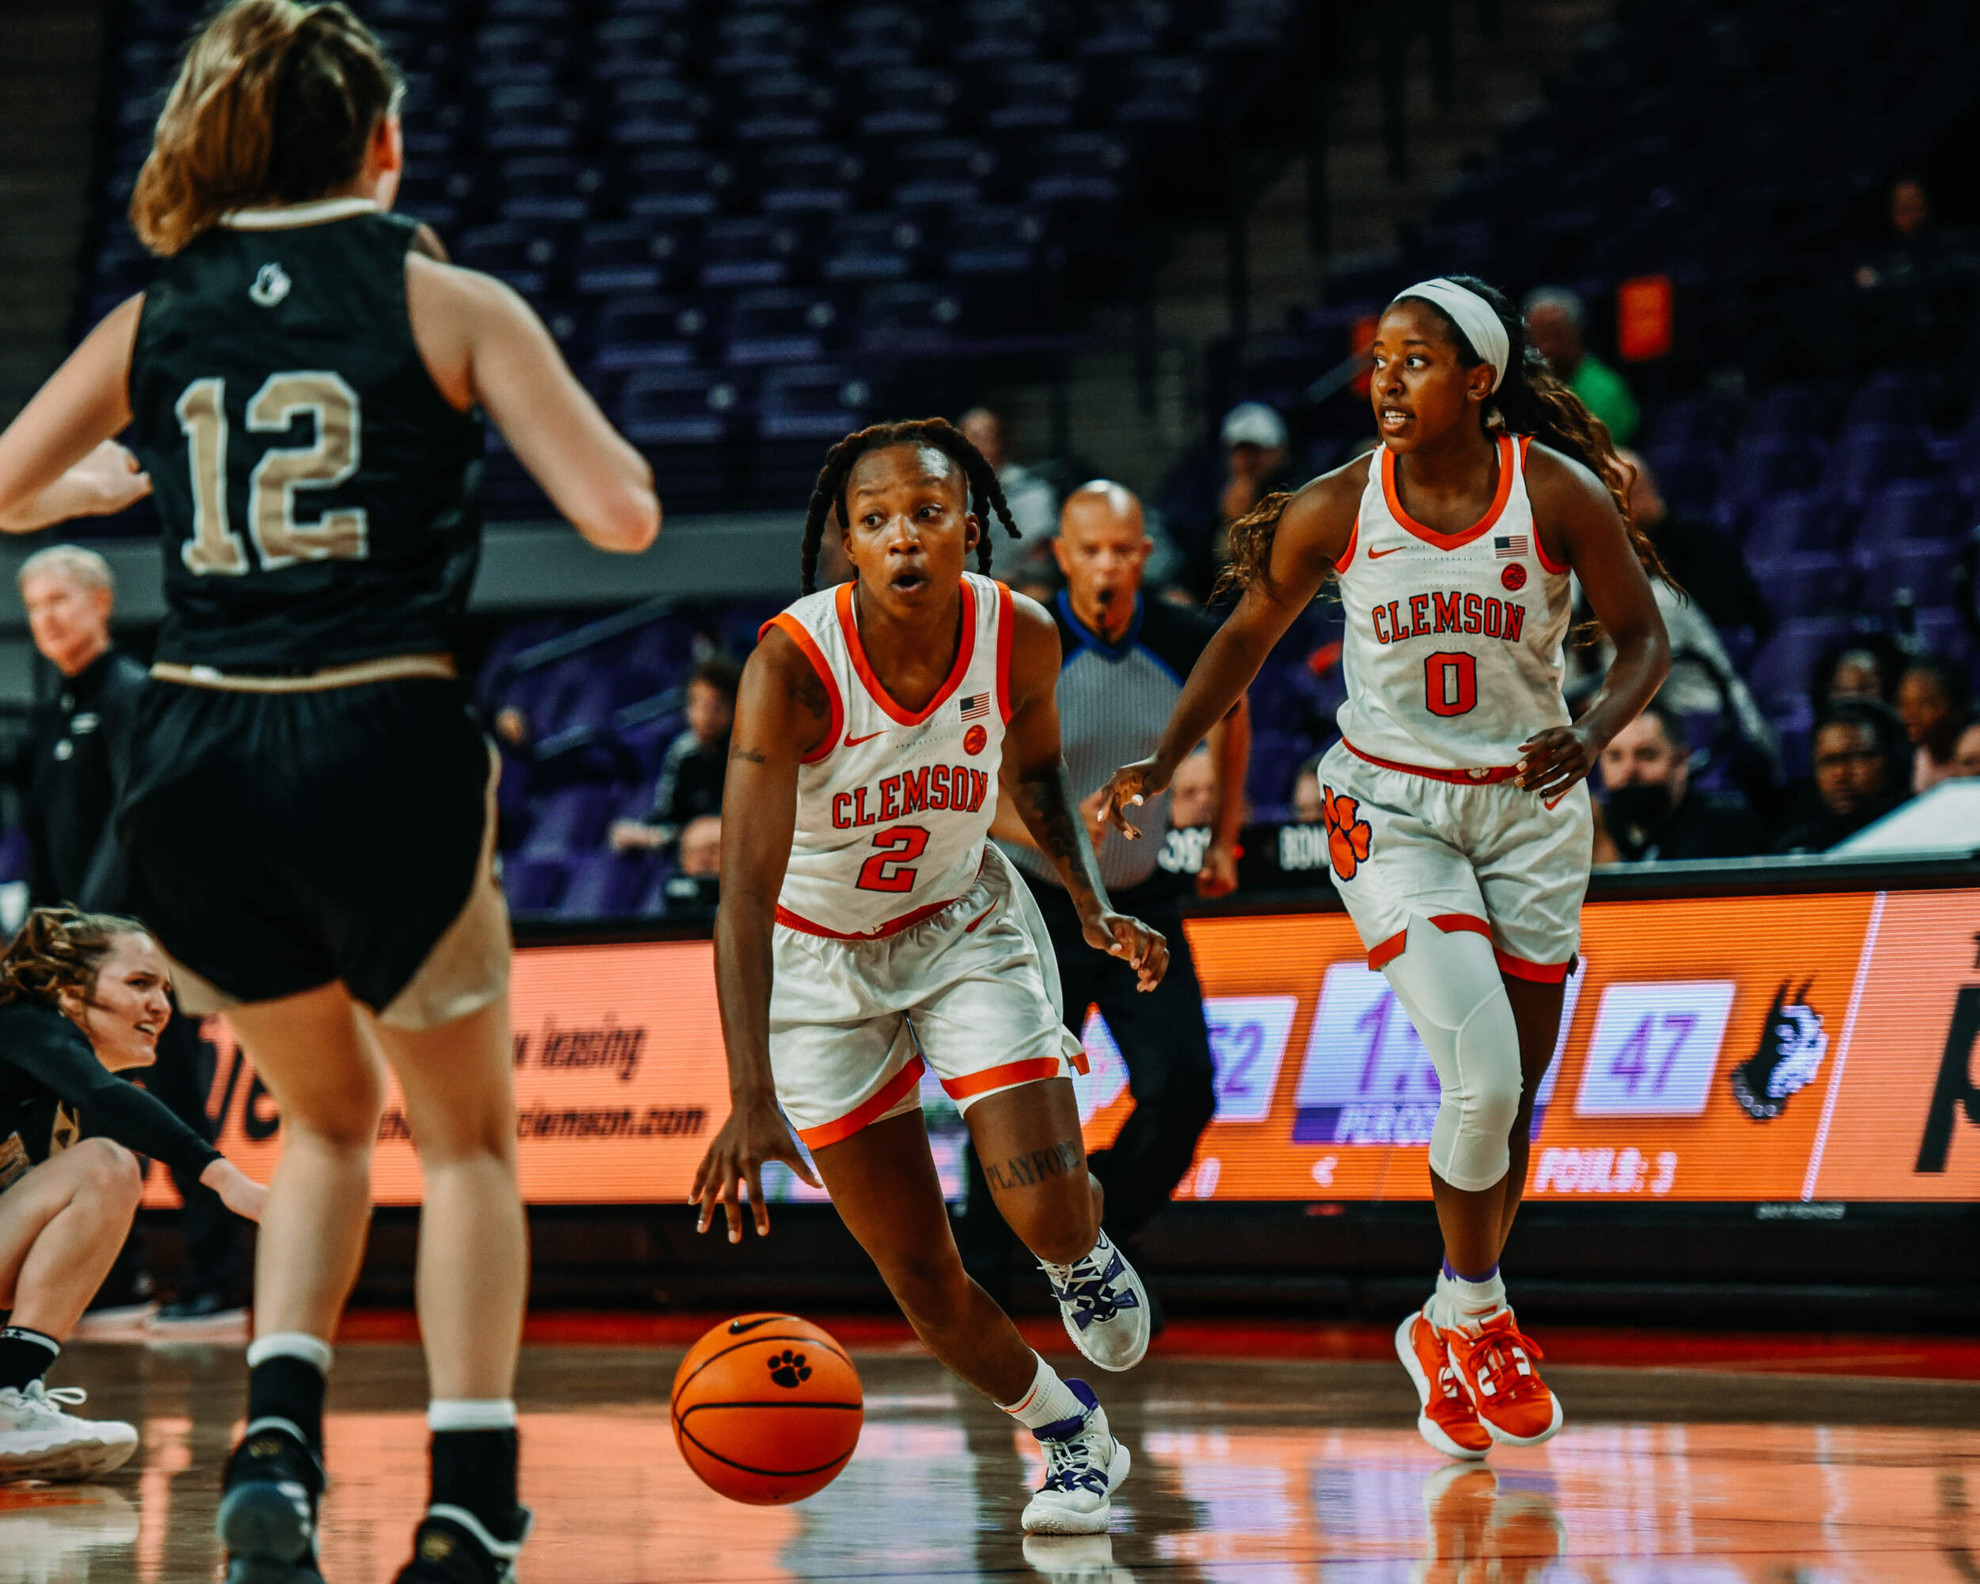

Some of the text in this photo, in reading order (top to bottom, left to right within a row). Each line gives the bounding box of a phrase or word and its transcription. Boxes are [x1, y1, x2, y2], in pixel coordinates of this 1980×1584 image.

[175, 370, 369, 577] 12
[1371, 590, 1526, 645] CLEMSON
[1423, 650, 1478, 718] 0
[831, 763, 989, 830] CLEMSON
[854, 824, 931, 893] 2
[1610, 1011, 1698, 1096] 47
